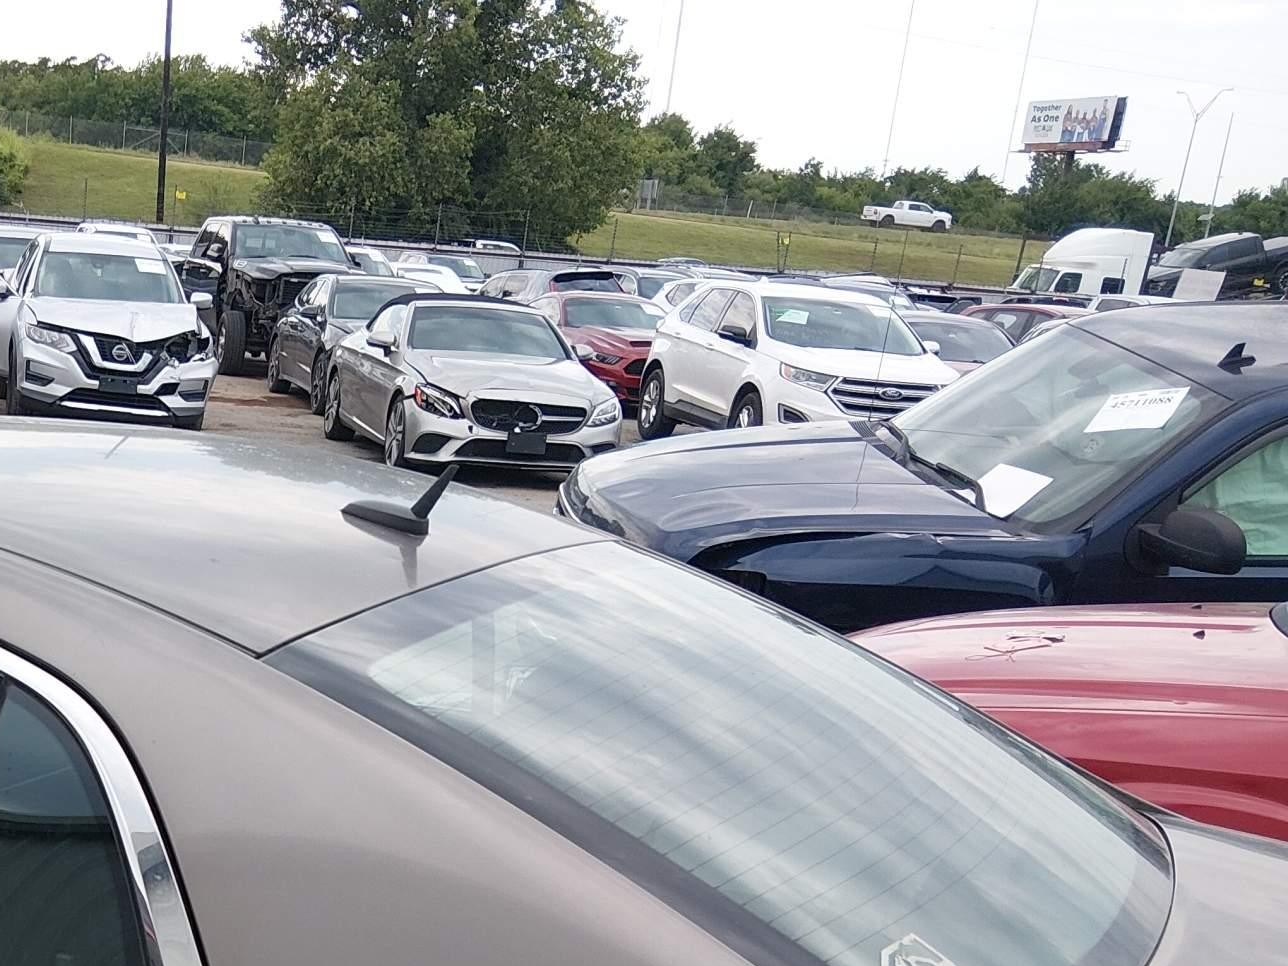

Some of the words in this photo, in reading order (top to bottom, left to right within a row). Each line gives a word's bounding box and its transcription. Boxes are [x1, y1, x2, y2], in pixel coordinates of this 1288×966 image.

[1033, 104, 1062, 113] Together
[1031, 115, 1042, 123] As
[1043, 114, 1059, 122] One
